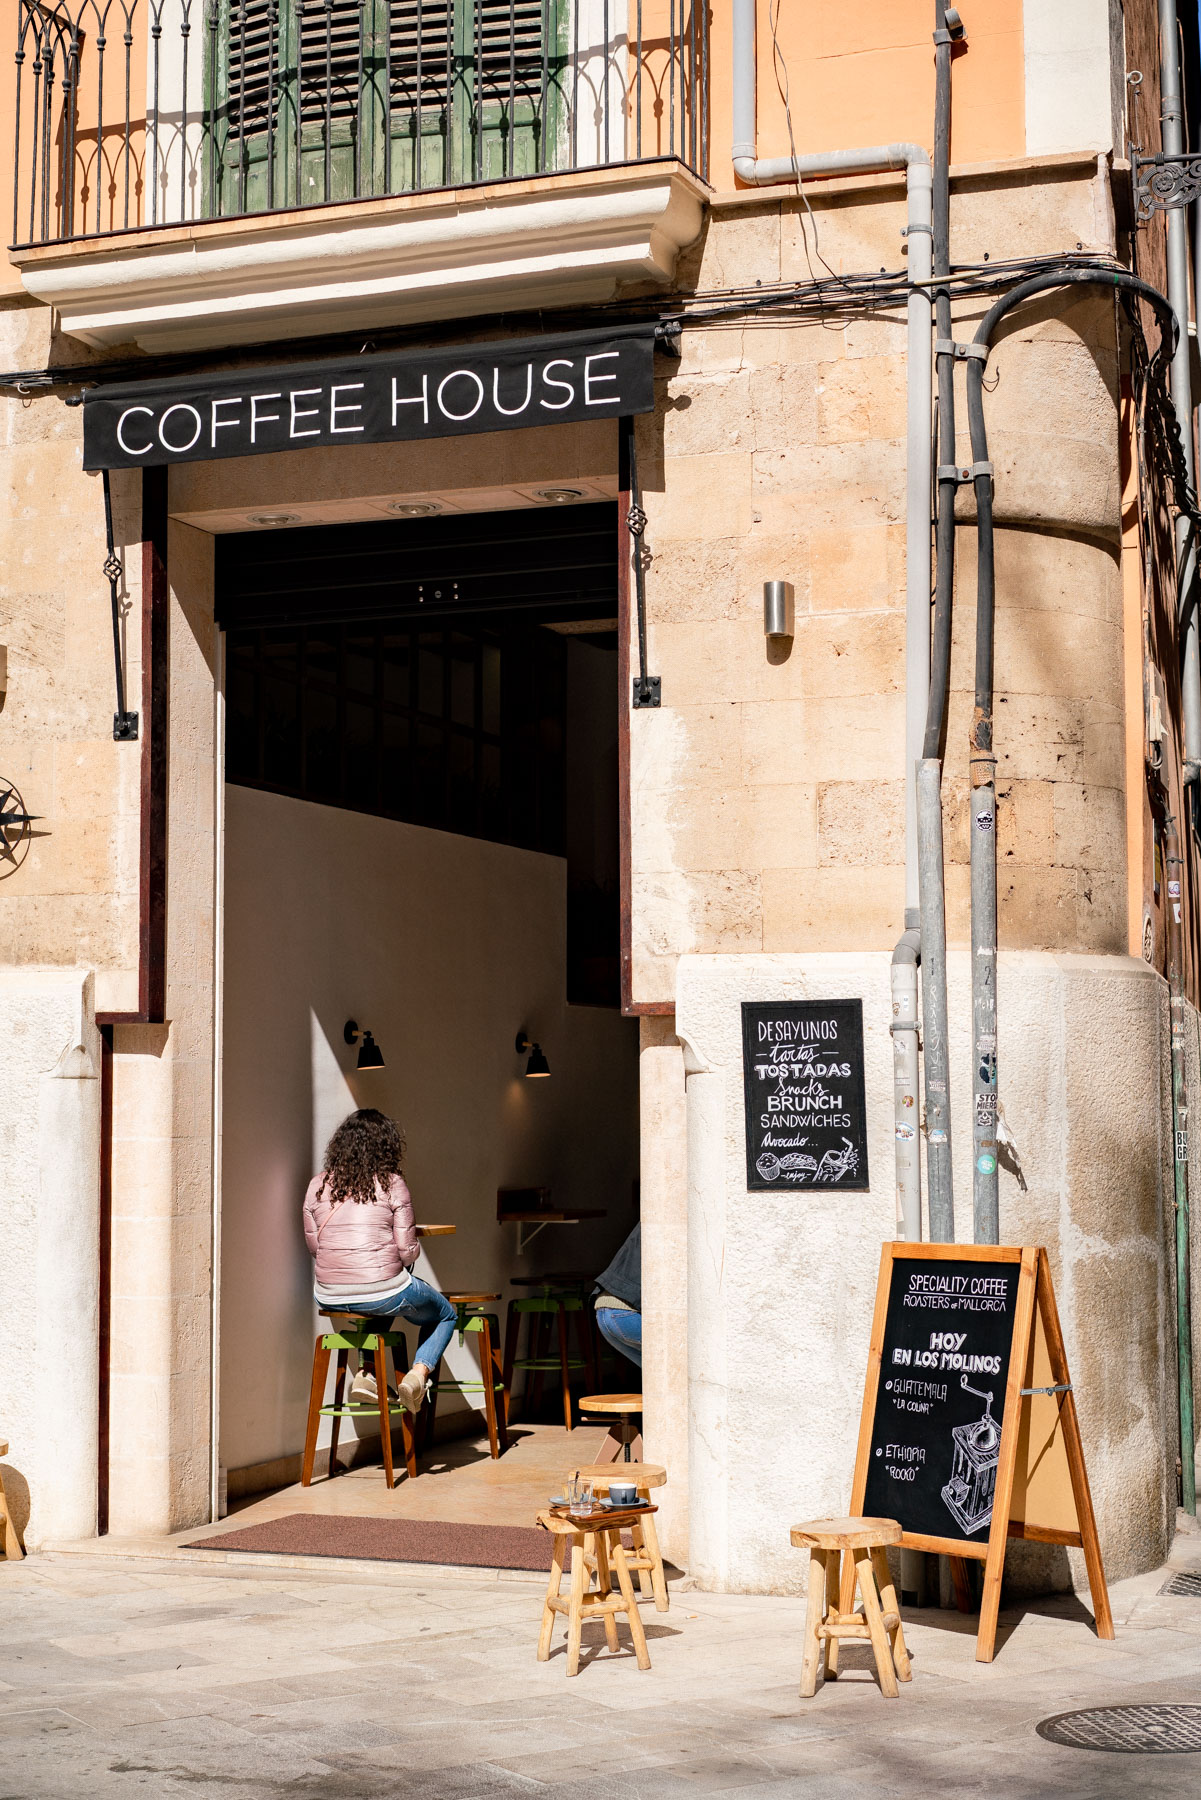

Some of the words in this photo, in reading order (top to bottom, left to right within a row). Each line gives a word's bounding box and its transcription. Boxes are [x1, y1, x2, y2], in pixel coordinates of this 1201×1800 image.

[116, 383, 365, 455] COFFEE
[391, 351, 621, 427] HOUSE
[758, 1020, 838, 1042] DESAYUNOS
[769, 1042, 820, 1063] tartas
[754, 1063, 852, 1080] TOSTADAS
[774, 1077, 830, 1097] Snacks
[767, 1095, 842, 1112] BRUNCH
[909, 1274, 969, 1294] SPECIALITY
[970, 1277, 1009, 1297] COFFEE
[902, 1294, 950, 1310] ROASTERS
[958, 1298, 1007, 1313] MALLORCA
[929, 1332, 968, 1353] HOY
[891, 1348, 912, 1367] EN
[913, 1350, 940, 1369] LOS
[938, 1352, 1002, 1375] MOLINOS
[893, 1378, 948, 1402] GUATEMALA
[885, 1444, 926, 1464] ETHIOPIA
